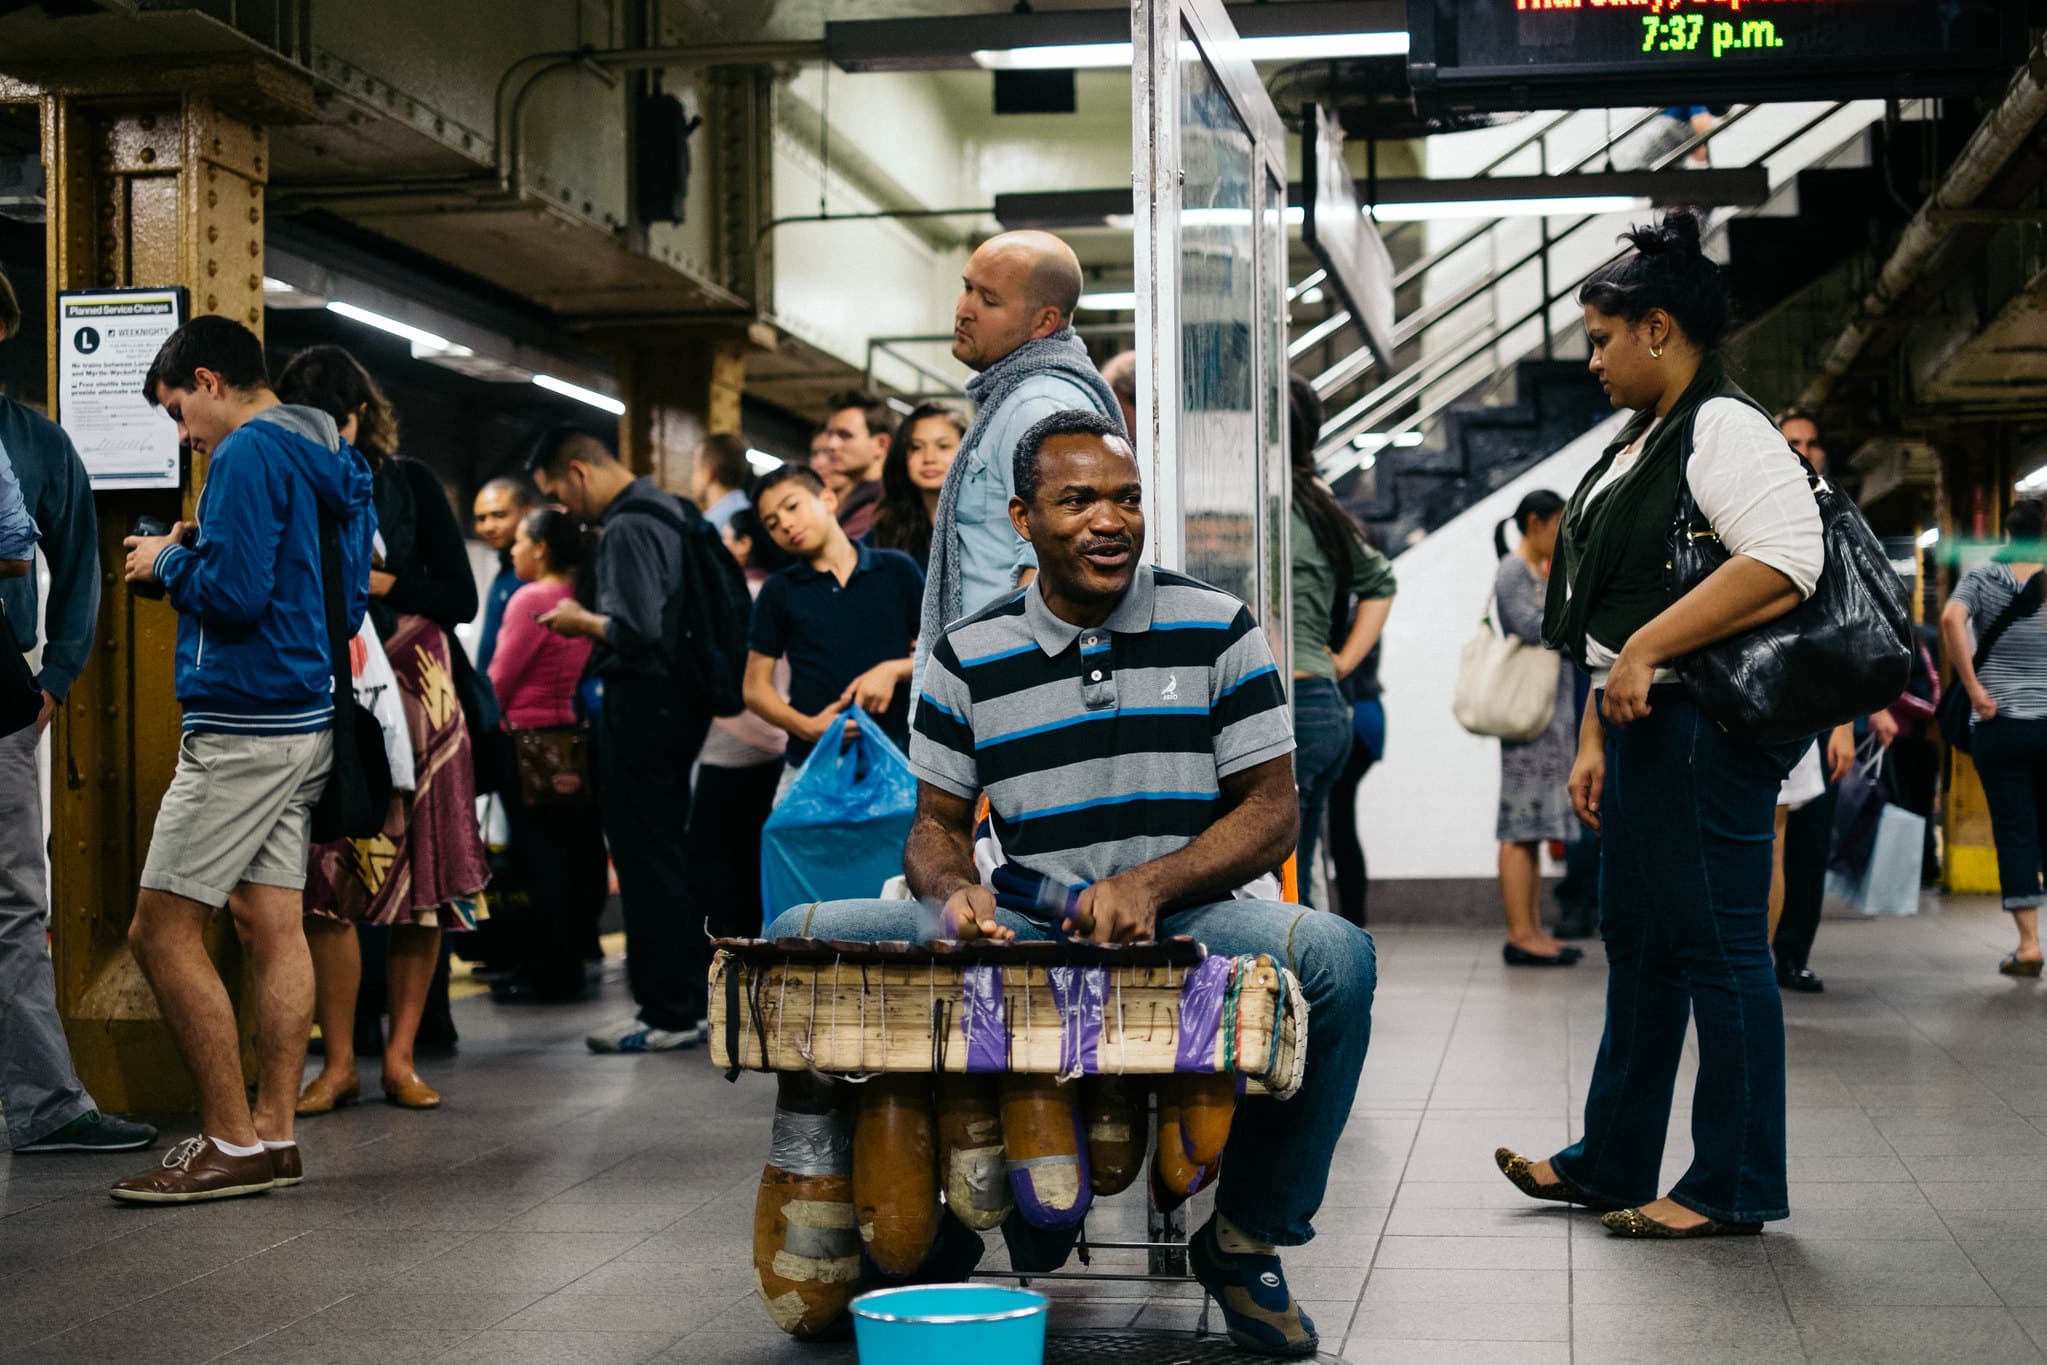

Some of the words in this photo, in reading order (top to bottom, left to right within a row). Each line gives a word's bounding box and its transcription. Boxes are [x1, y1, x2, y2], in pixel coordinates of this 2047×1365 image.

[1642, 15, 1704, 52] 7:37
[1713, 20, 1784, 58] p.m.
[69, 305, 102, 316] Planned
[103, 304, 133, 315] Service
[134, 303, 169, 315] Changes
[118, 327, 169, 337] WEEKNIGHTS
[82, 331, 93, 349] L
